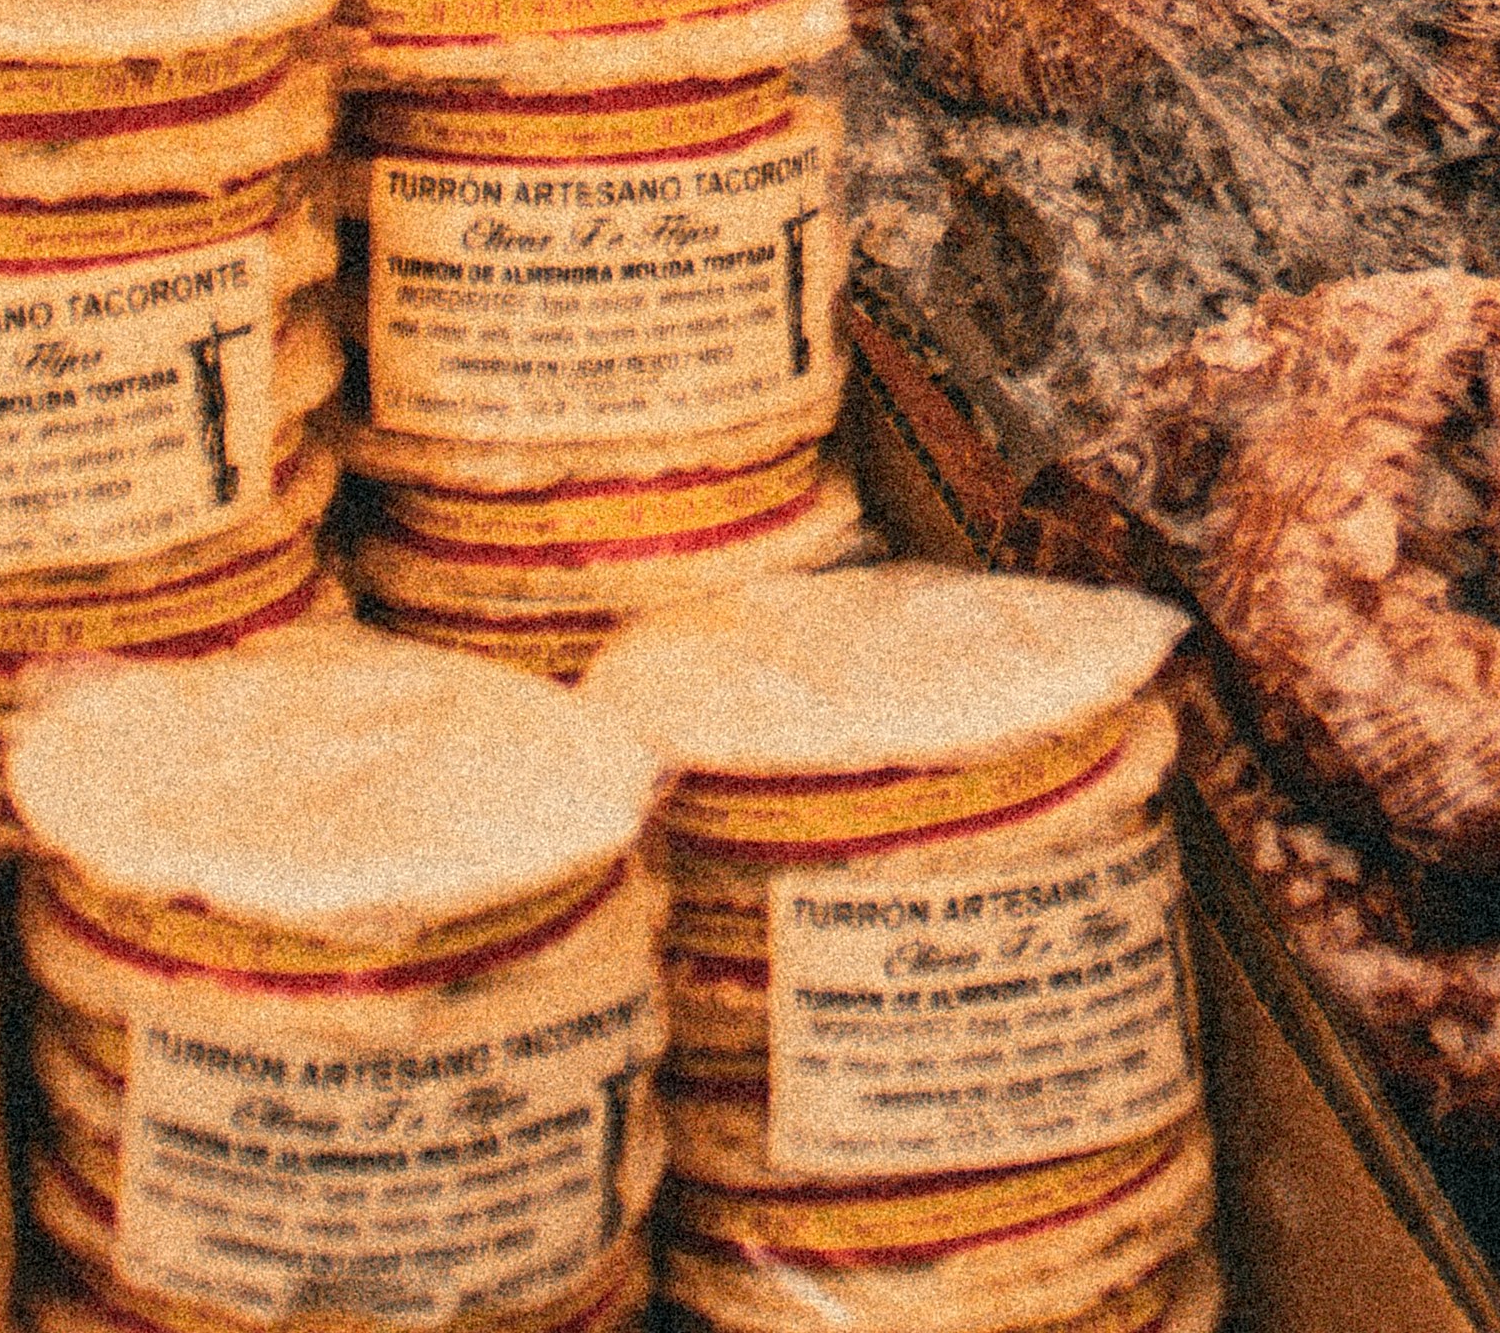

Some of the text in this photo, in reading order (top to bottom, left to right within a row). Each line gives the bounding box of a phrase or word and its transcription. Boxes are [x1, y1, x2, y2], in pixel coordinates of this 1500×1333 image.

[387, 169, 504, 207] TURRÓN
[513, 175, 683, 208] ARTESANO
[693, 147, 822, 197] TACORONTE
[64, 259, 250, 323] TACORONTE
[793, 897, 931, 930] TURRÓN
[943, 871, 1100, 922] ARTESANO
[145, 1027, 289, 1084] TURRÓN
[299, 1044, 495, 1091] ARTESANO
